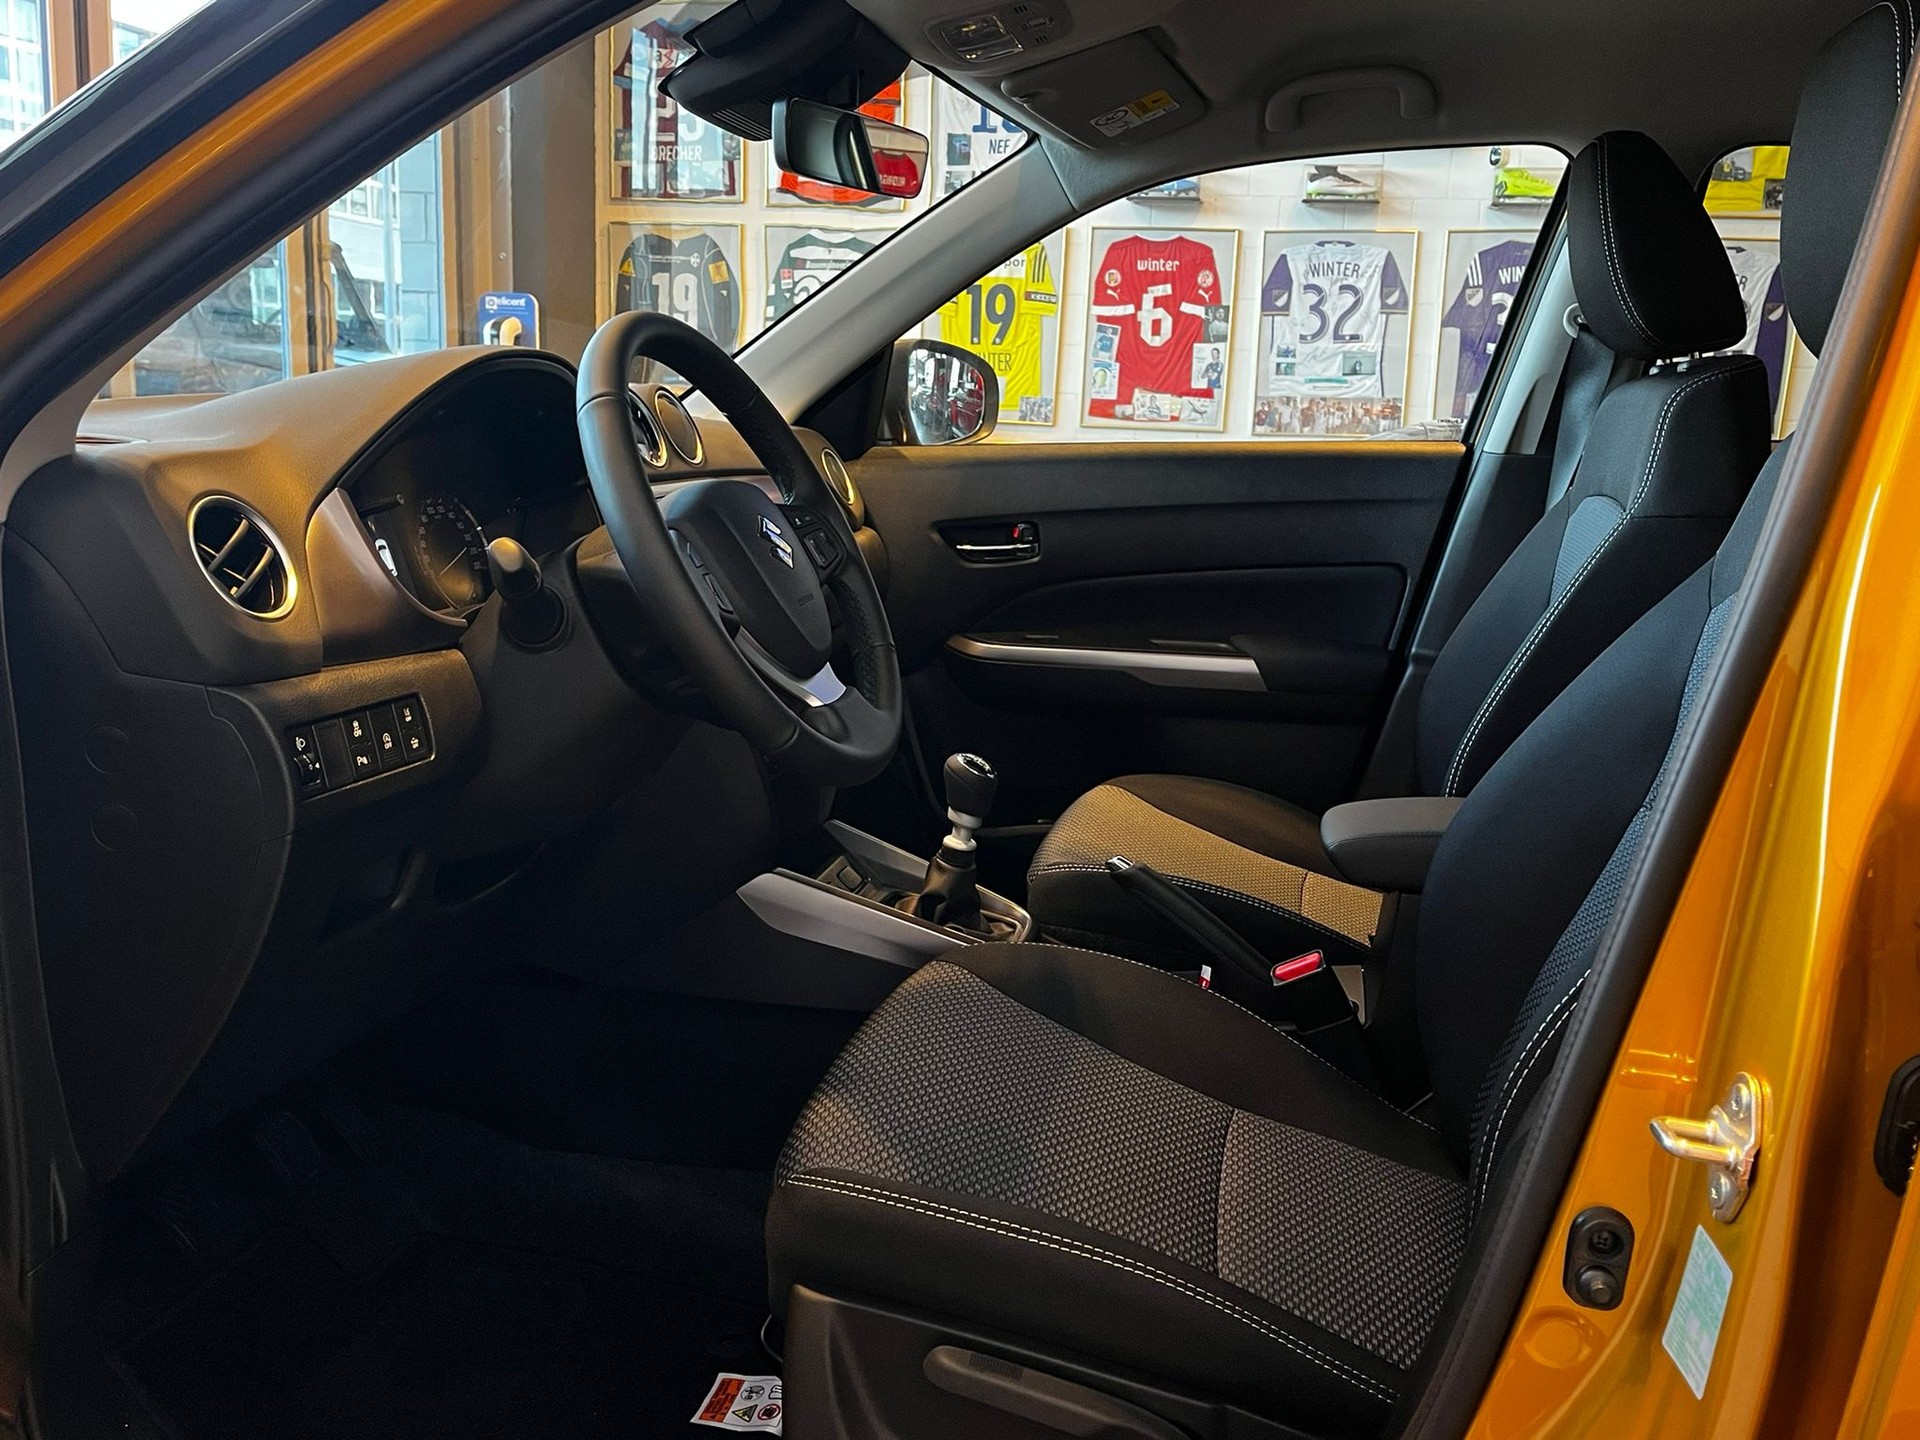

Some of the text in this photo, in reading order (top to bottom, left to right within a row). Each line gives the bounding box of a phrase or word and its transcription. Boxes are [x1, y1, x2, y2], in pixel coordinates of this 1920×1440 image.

[988, 138, 1011, 155] NEF
[1137, 258, 1180, 272] winter
[1309, 261, 1361, 278] WINTER
[652, 272, 698, 330] 19
[966, 283, 1016, 345] 19
[1137, 284, 1173, 347] 6
[1299, 283, 1363, 344] 32
